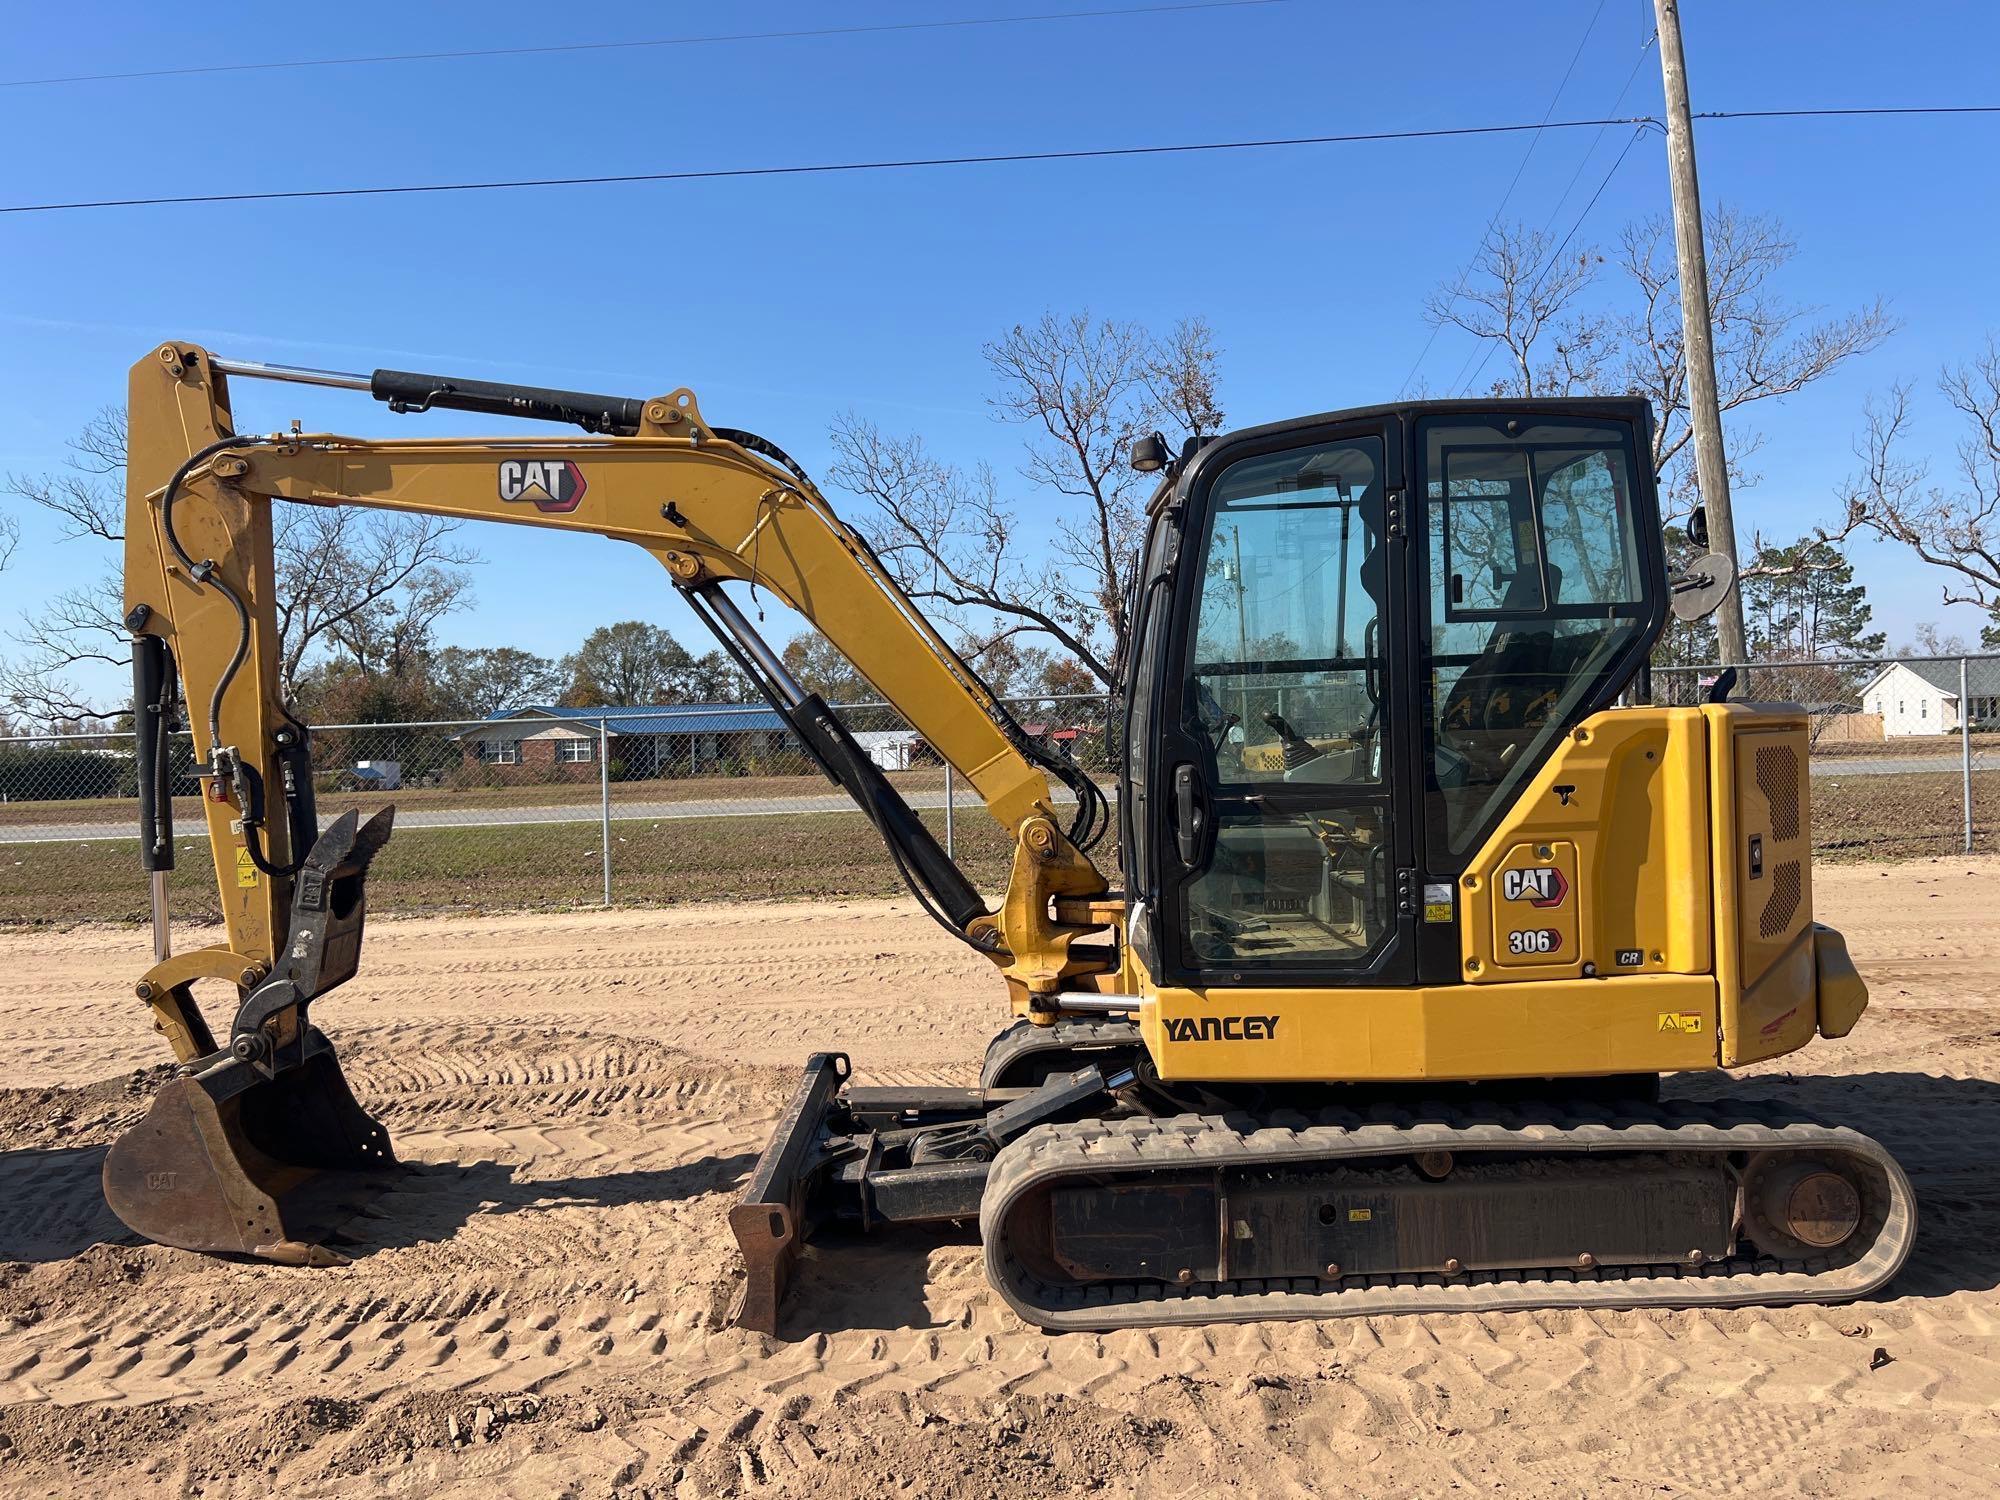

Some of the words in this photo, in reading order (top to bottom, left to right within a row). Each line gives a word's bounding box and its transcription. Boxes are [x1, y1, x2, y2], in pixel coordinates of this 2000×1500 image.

[500, 460, 565, 501] CAT
[1503, 869, 1552, 900] CAT
[1509, 930, 1550, 954] 306
[1621, 952, 1639, 964] CR
[1161, 1015, 1280, 1042] YANCEY
[148, 1172, 177, 1191] CAT
